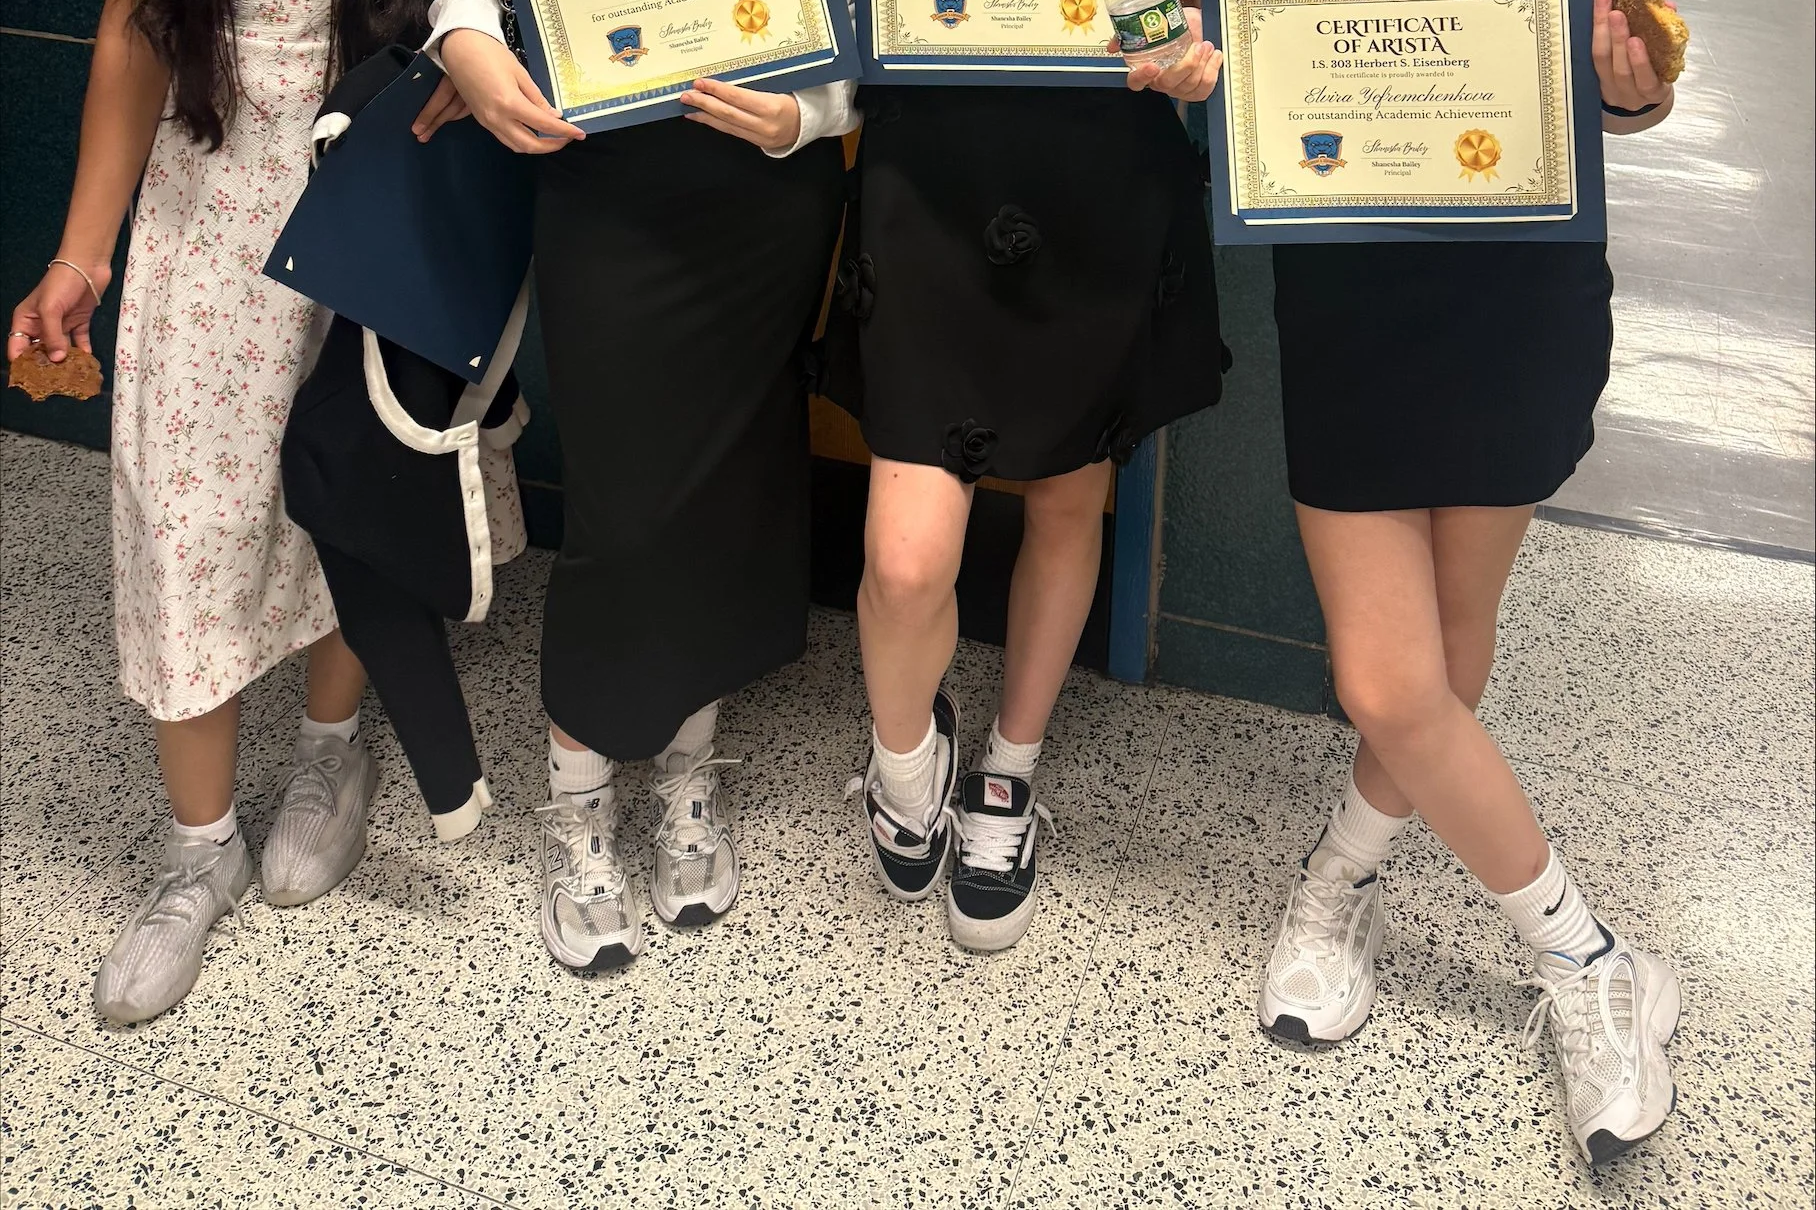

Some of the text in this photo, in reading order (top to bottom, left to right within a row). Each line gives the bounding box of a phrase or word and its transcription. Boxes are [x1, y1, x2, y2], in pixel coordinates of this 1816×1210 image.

[591, 13, 606, 23] for
[608, 0, 663, 19] outstanding
[1316, 16, 1464, 37] CERTIFICATE
[1333, 37, 1451, 56] OF ARISTA
[1312, 57, 1470, 69] I.S. 303 Herbert S. Eisenberg
[1388, 71, 1415, 80] proudly
[1304, 85, 1354, 105] Elvira
[1287, 109, 1513, 122] for outstanding Academic Achievement
[1384, 169, 1412, 177] Principal
